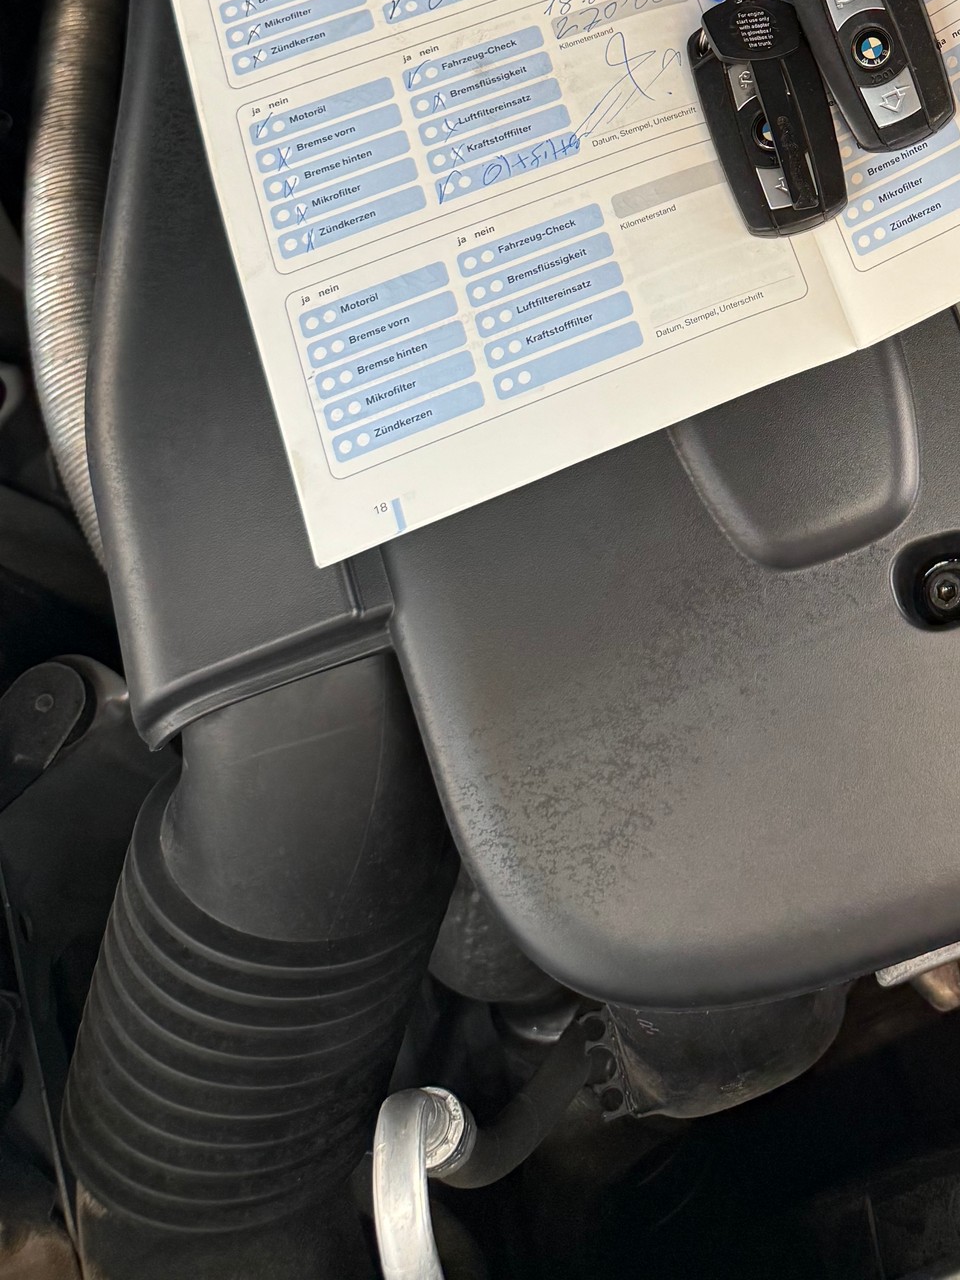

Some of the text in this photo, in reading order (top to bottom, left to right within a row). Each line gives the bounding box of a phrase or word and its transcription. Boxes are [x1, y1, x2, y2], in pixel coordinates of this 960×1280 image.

[264, 8, 312, 28] Mikrofilter
[271, 31, 326, 55] Zündkerzen
[559, 27, 614, 50] Kilometerstand
[403, 45, 439, 63] ja nein
[441, 40, 517, 70] Fahrzeug-Check
[861, 50, 888, 64] BMW
[450, 66, 527, 97] Bremsflüssigkeit
[252, 97, 289, 116] ja nein
[289, 105, 326, 123] Motoröl
[458, 95, 531, 124] Luftfiltereinsatz
[297, 126, 355, 151] Bremse vorn
[467, 124, 532, 152] Kraftstofffilter
[592, 107, 697, 148] Datum, Stempel, Unterschrift
[304, 150, 372, 179] Bremse hinten
[867, 142, 928, 176] Bremse hinten
[312, 184, 361, 207] Mikrofilter
[878, 177, 923, 203] Mikrofilter
[319, 210, 376, 236] Zündkerzen
[620, 204, 677, 231] Kilometerstand
[890, 202, 942, 231] Zündkerzen
[457, 226, 495, 246] ja nein
[498, 220, 576, 253] Fahrzeug-Check
[507, 249, 587, 283] Bremsflüssigkeit
[301, 284, 340, 305] ja nein
[340, 293, 379, 313] Motoröl
[516, 280, 592, 314] Luftfiltereinsatz
[656, 292, 764, 338] Datum, Stempel, Unterschrift
[349, 316, 410, 344] Bremse vorn
[526, 314, 593, 345] Kraftstofffilter
[357, 342, 428, 374] Bremse hinten
[365, 379, 417, 405] Mikrofilter
[374, 409, 433, 437] Zündkerzen
[374, 502, 388, 514] 18
